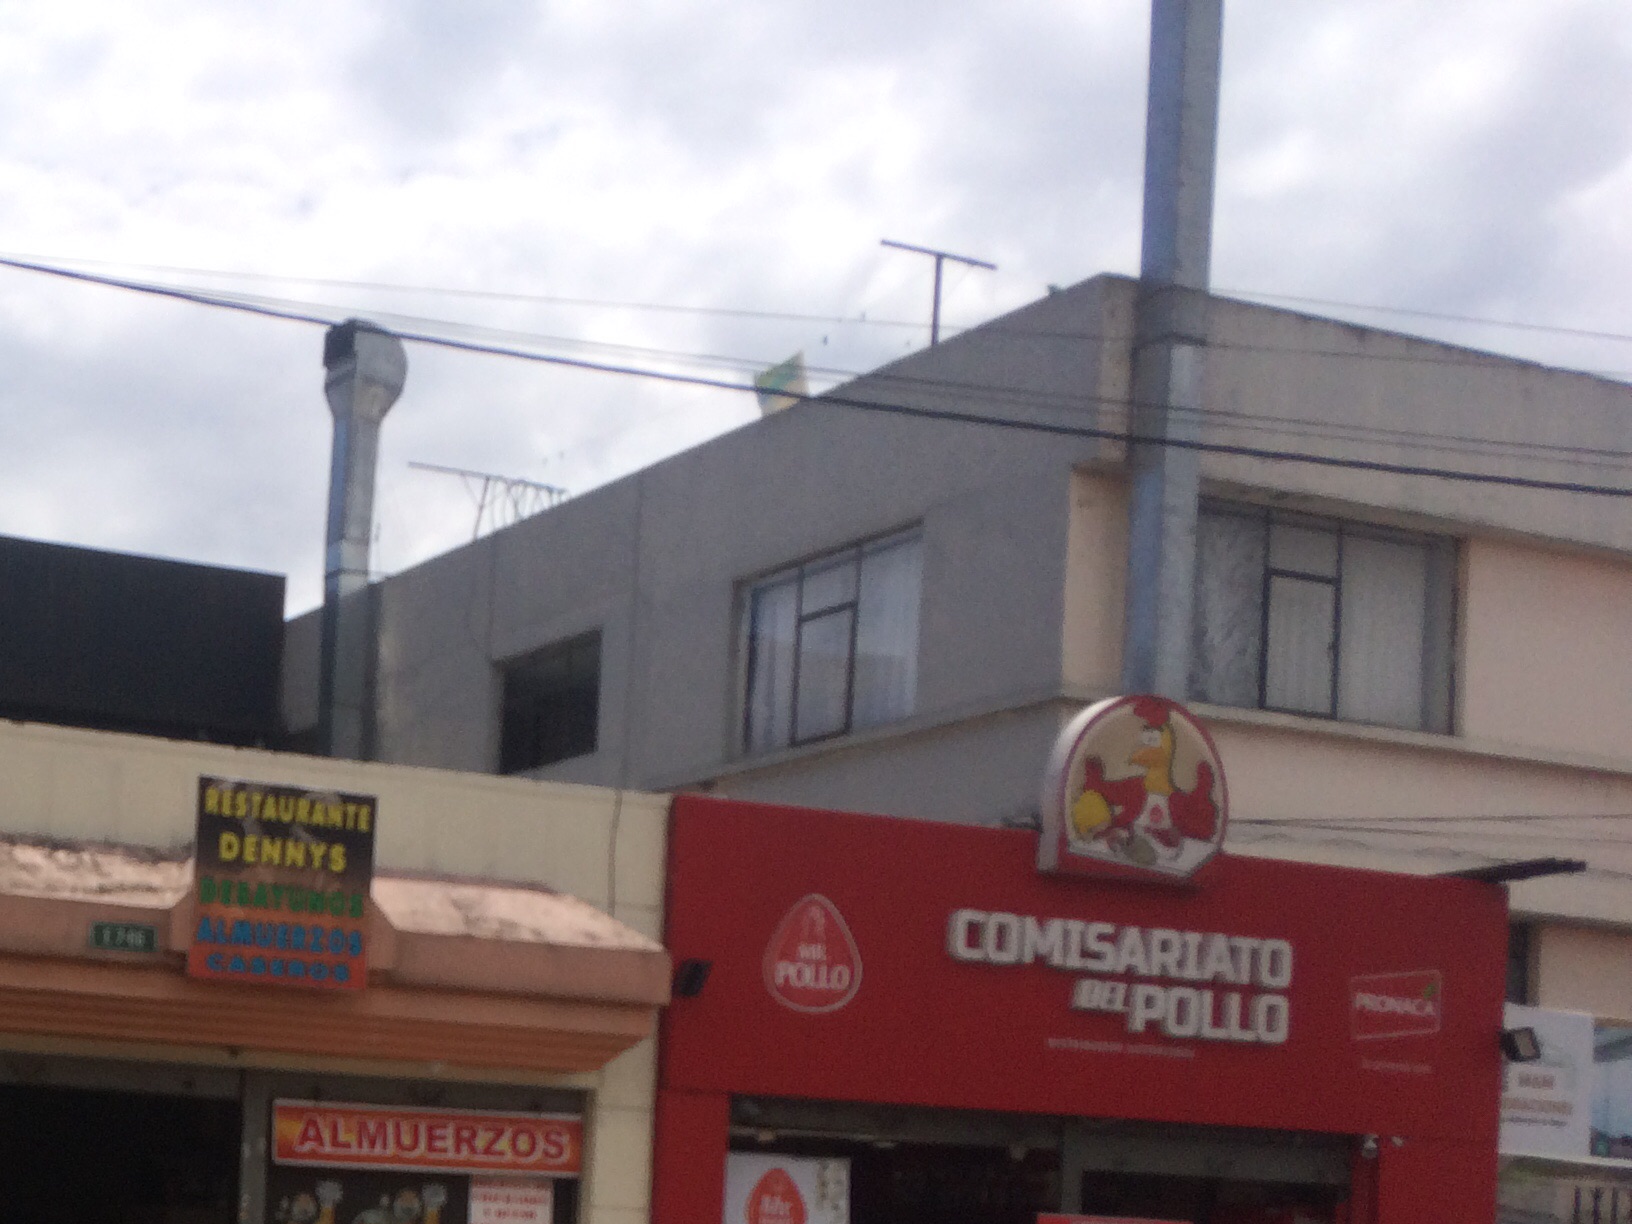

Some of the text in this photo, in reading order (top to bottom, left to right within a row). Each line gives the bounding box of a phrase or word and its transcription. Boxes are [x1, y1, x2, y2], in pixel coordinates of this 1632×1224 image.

[206, 787, 370, 832] RESTAURANTE
[218, 831, 347, 874] DENNYS
[196, 916, 364, 957] ALMUERZOS
[946, 908, 1293, 990] COMISARIATO
[205, 952, 351, 984] CASEROS
[774, 961, 851, 990] POLLO
[1072, 978, 1290, 1045] DEL POLLO
[1353, 992, 1436, 1016] PRONACA
[293, 1111, 570, 1163] ALMUERZOS
